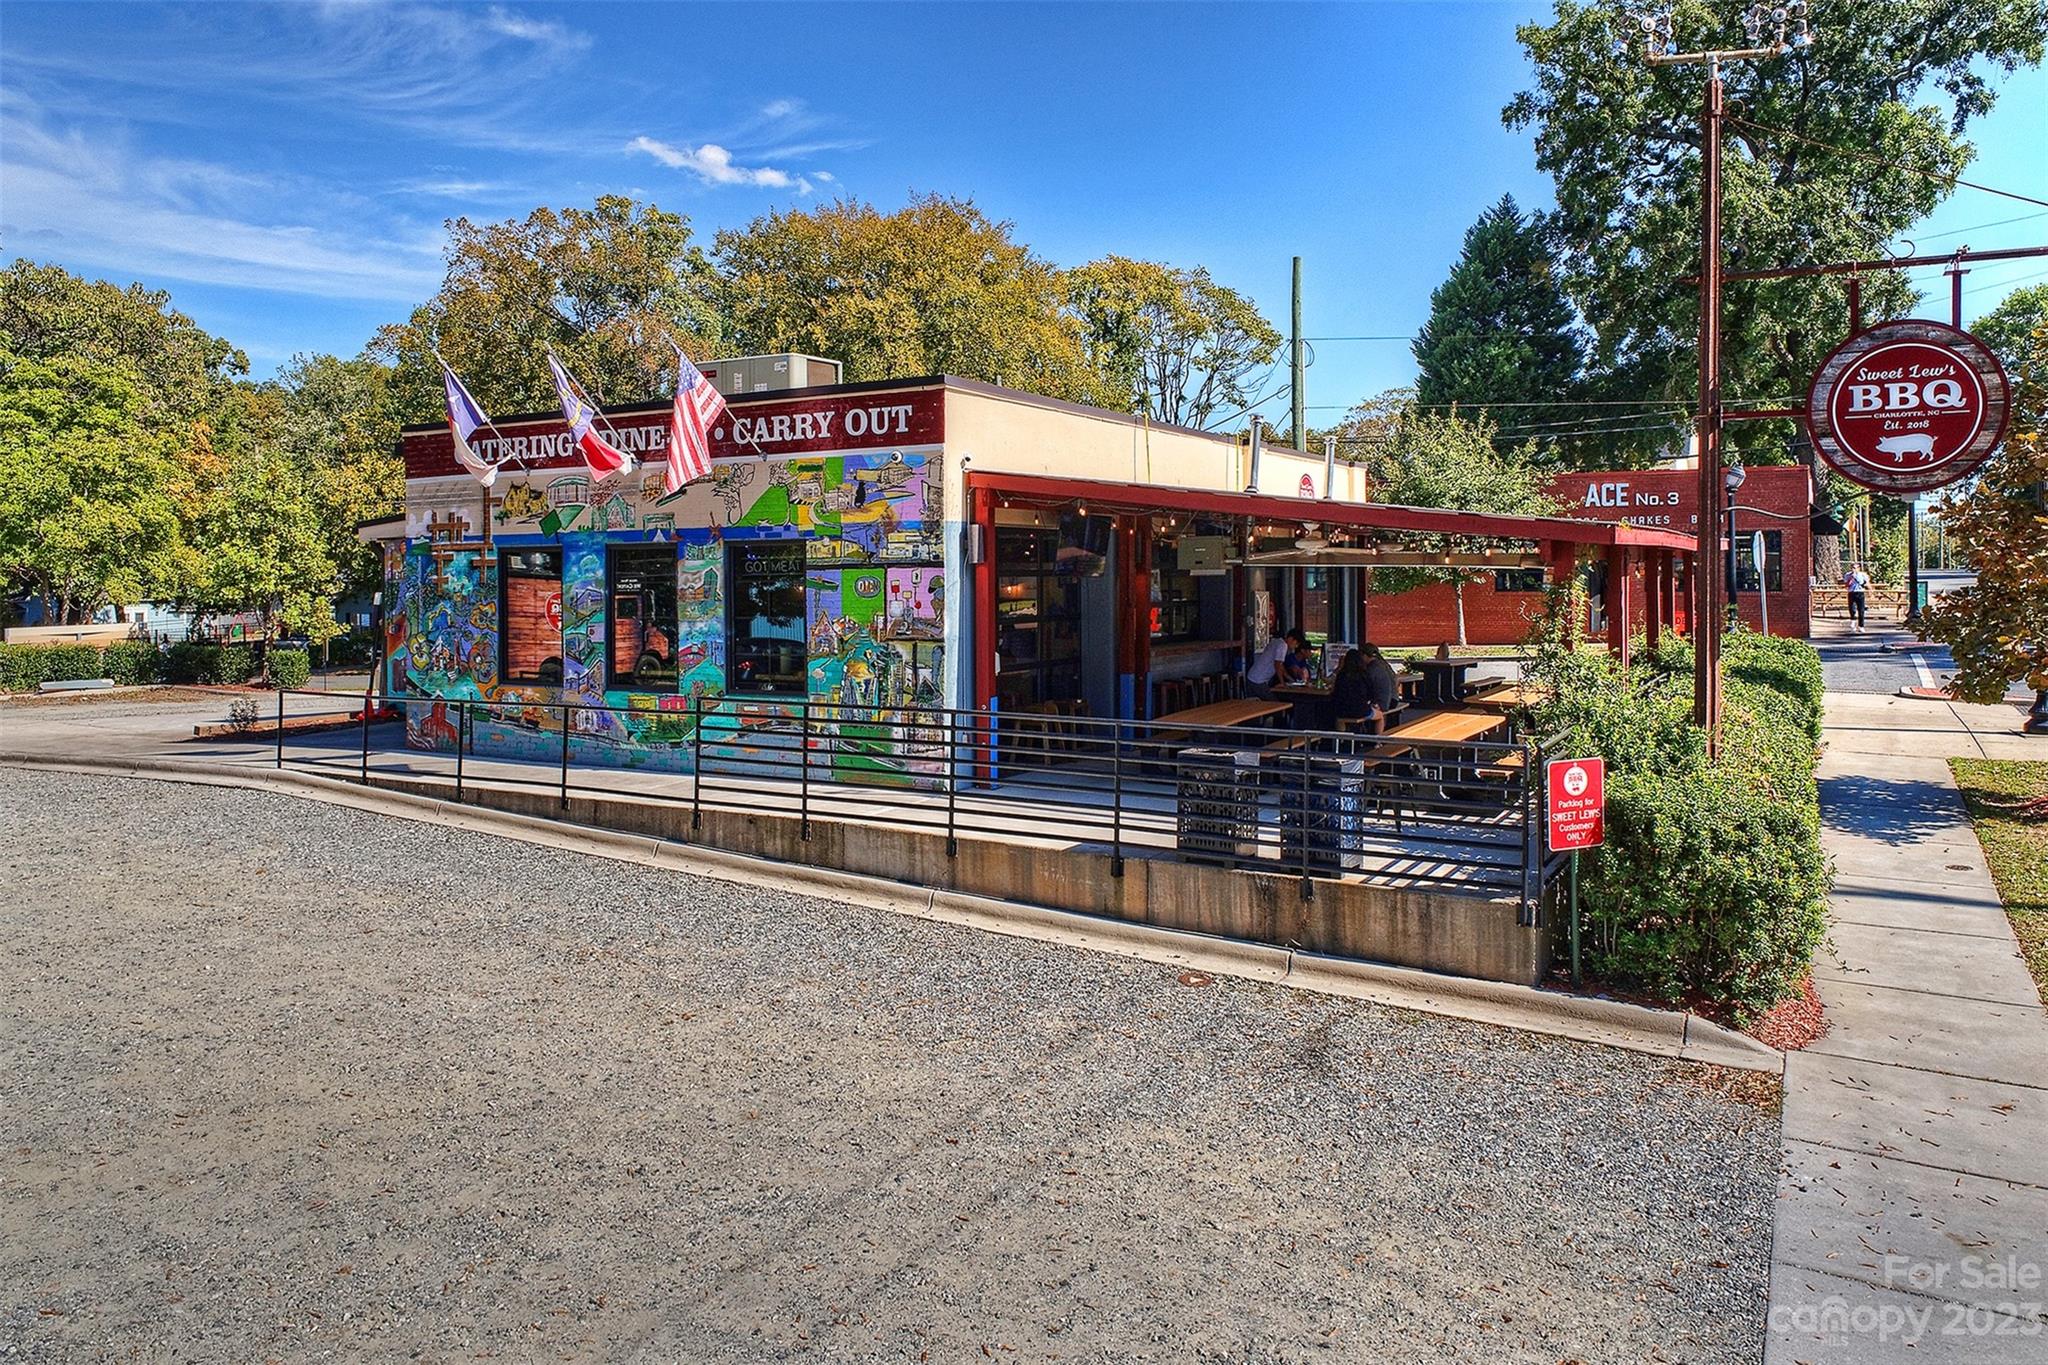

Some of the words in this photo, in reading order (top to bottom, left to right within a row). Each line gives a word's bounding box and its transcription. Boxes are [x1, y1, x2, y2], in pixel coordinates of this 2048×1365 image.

[1857, 368, 1904, 382] Sweet
[1908, 364, 1957, 379] Lew's
[1848, 379, 1967, 413] BBQ
[1883, 420, 1903, 430] Est.
[1906, 419, 1930, 430] 2018
[466, 432, 575, 463] ATERING
[733, 411, 836, 446] CARRY
[844, 405, 913, 437] OUT
[1585, 483, 1629, 507] ACE
[1636, 493, 1664, 506] No.
[1667, 492, 1679, 505] 3
[744, 560, 768, 573] GOT
[770, 559, 802, 573] MEAT
[1558, 800, 1583, 809] Parking
[1552, 811, 1576, 822] SWEET
[1559, 823, 1594, 832] Customers
[1567, 832, 1586, 841] ONLY
